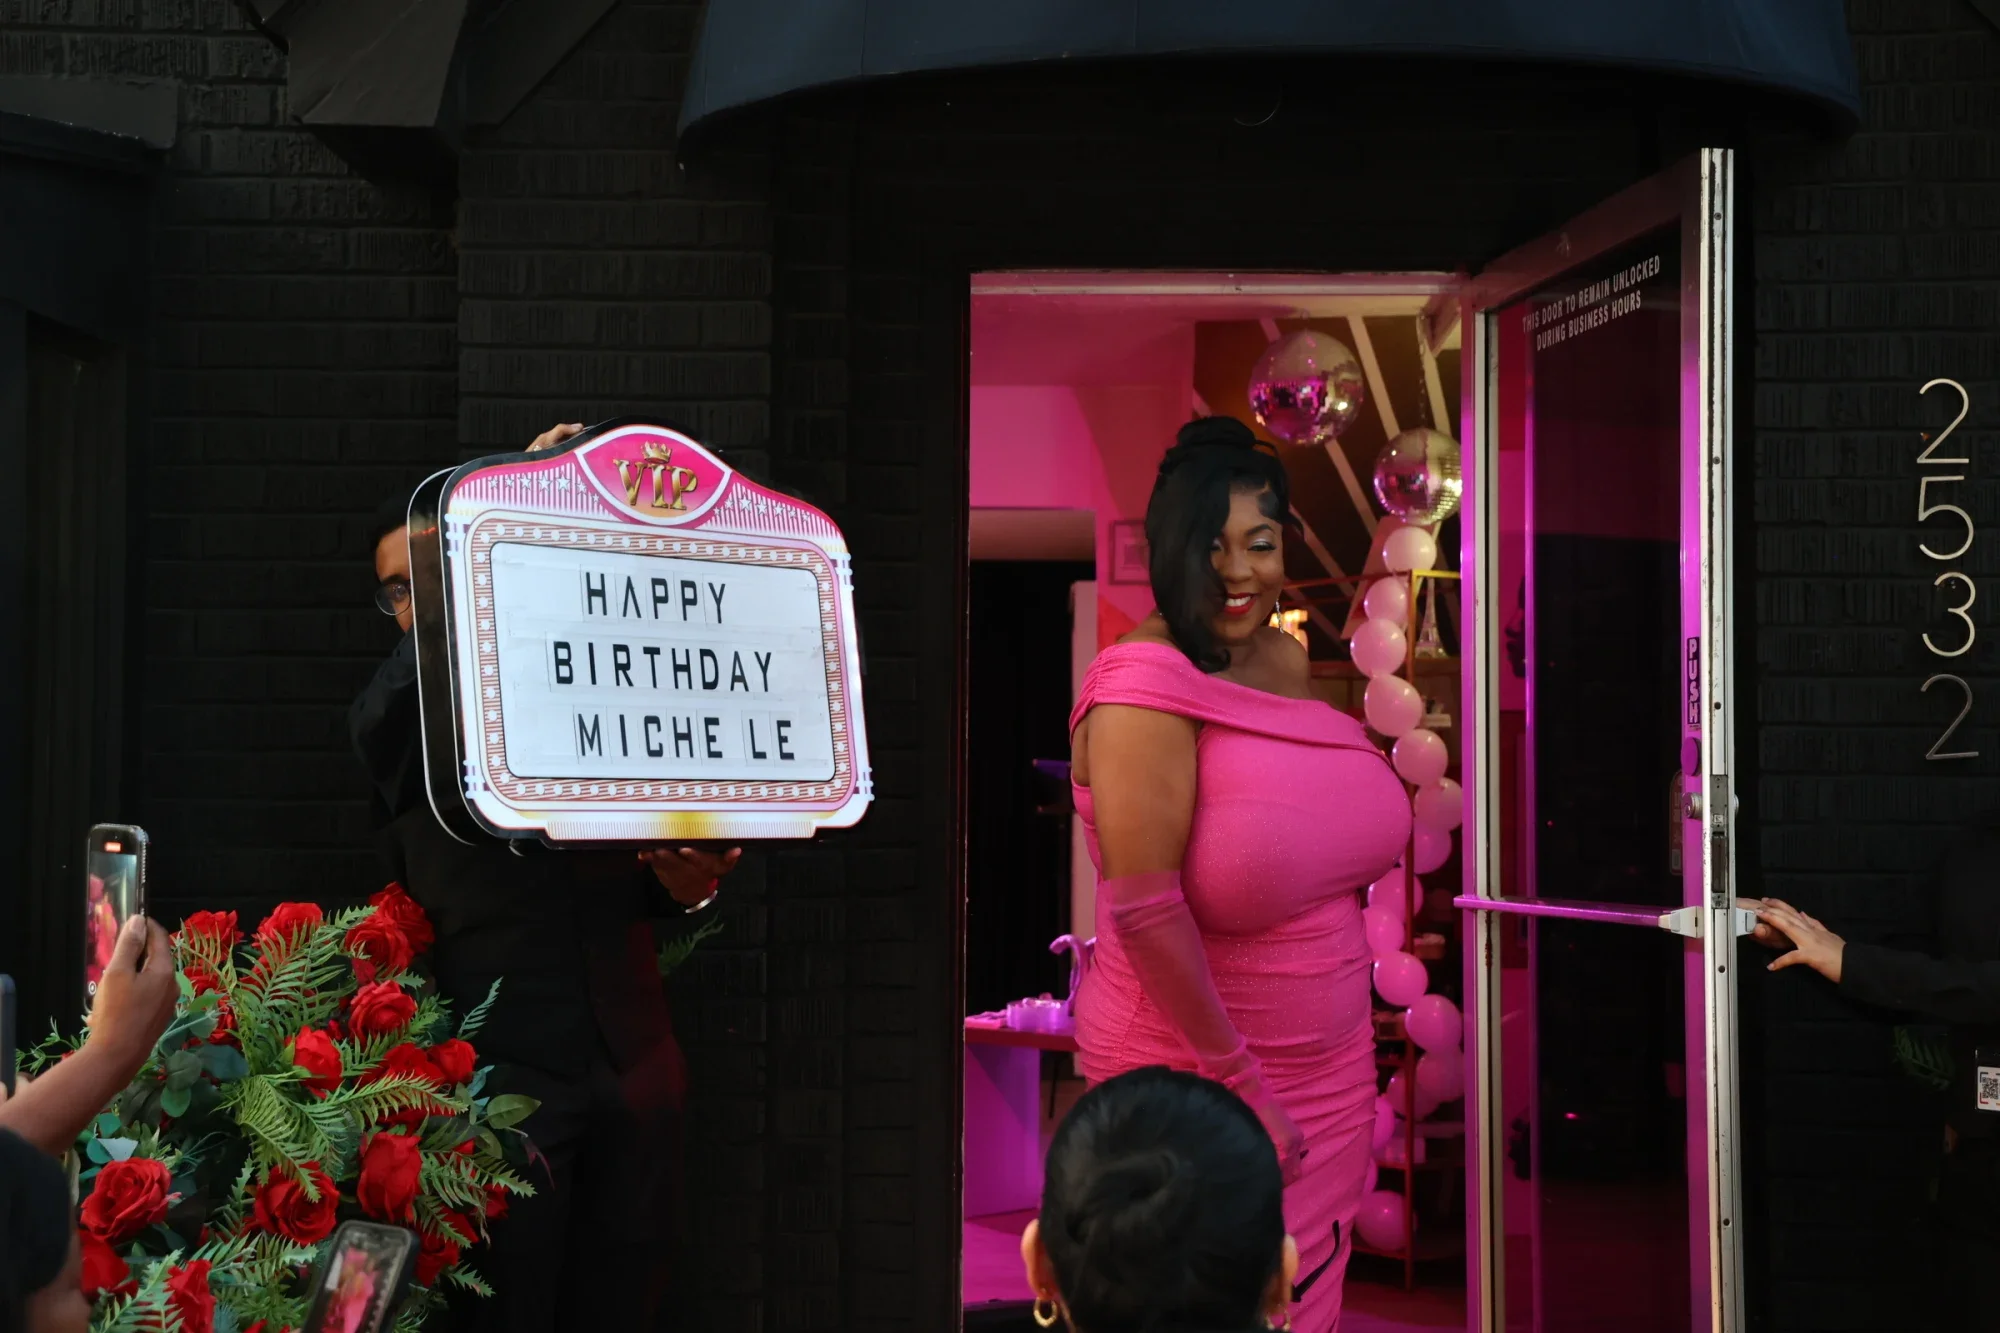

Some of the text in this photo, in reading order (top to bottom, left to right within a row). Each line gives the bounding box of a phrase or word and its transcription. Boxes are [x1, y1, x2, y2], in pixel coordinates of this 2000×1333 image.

[1522, 254, 1660, 334] THIS DOOR TO REMAIN UNLOCKED
[1536, 289, 1641, 351] DURING BUSINESS HOURS
[613, 458, 698, 510] VIP
[585, 571, 726, 624] HAPPY
[553, 641, 772, 693] BIRTHDAY
[1688, 637, 1700, 724] PUSH
